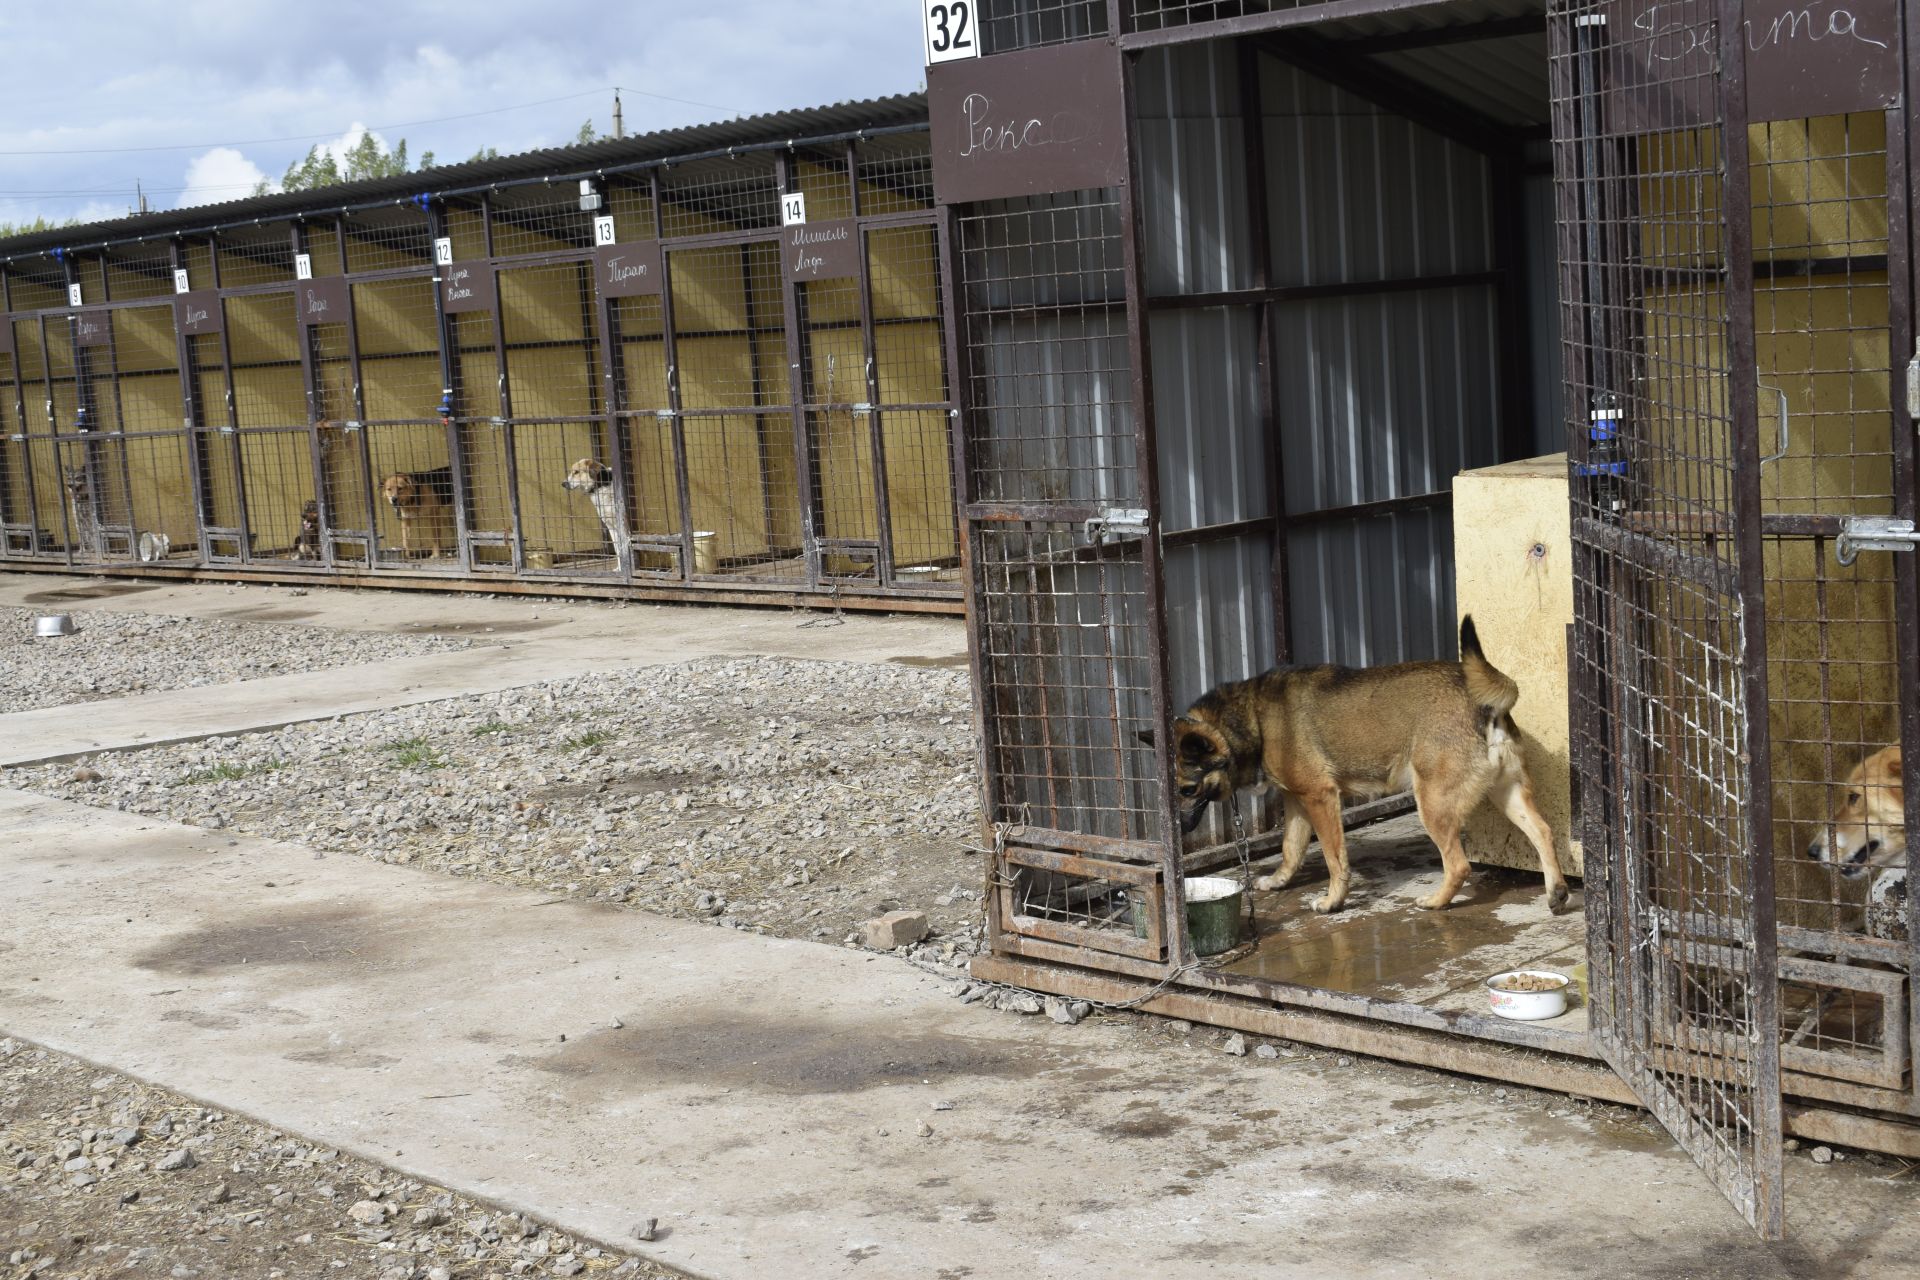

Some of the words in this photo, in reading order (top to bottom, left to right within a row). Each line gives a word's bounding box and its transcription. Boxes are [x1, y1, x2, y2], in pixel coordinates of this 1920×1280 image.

[930, 1, 972, 52] 32
[785, 200, 802, 221] 14
[598, 222, 612, 241] 13
[437, 244, 449, 261] 12
[299, 260, 308, 276] 11
[607, 255, 647, 288] Пират
[177, 274, 187, 290] 10
[73, 288, 79, 303] 9
